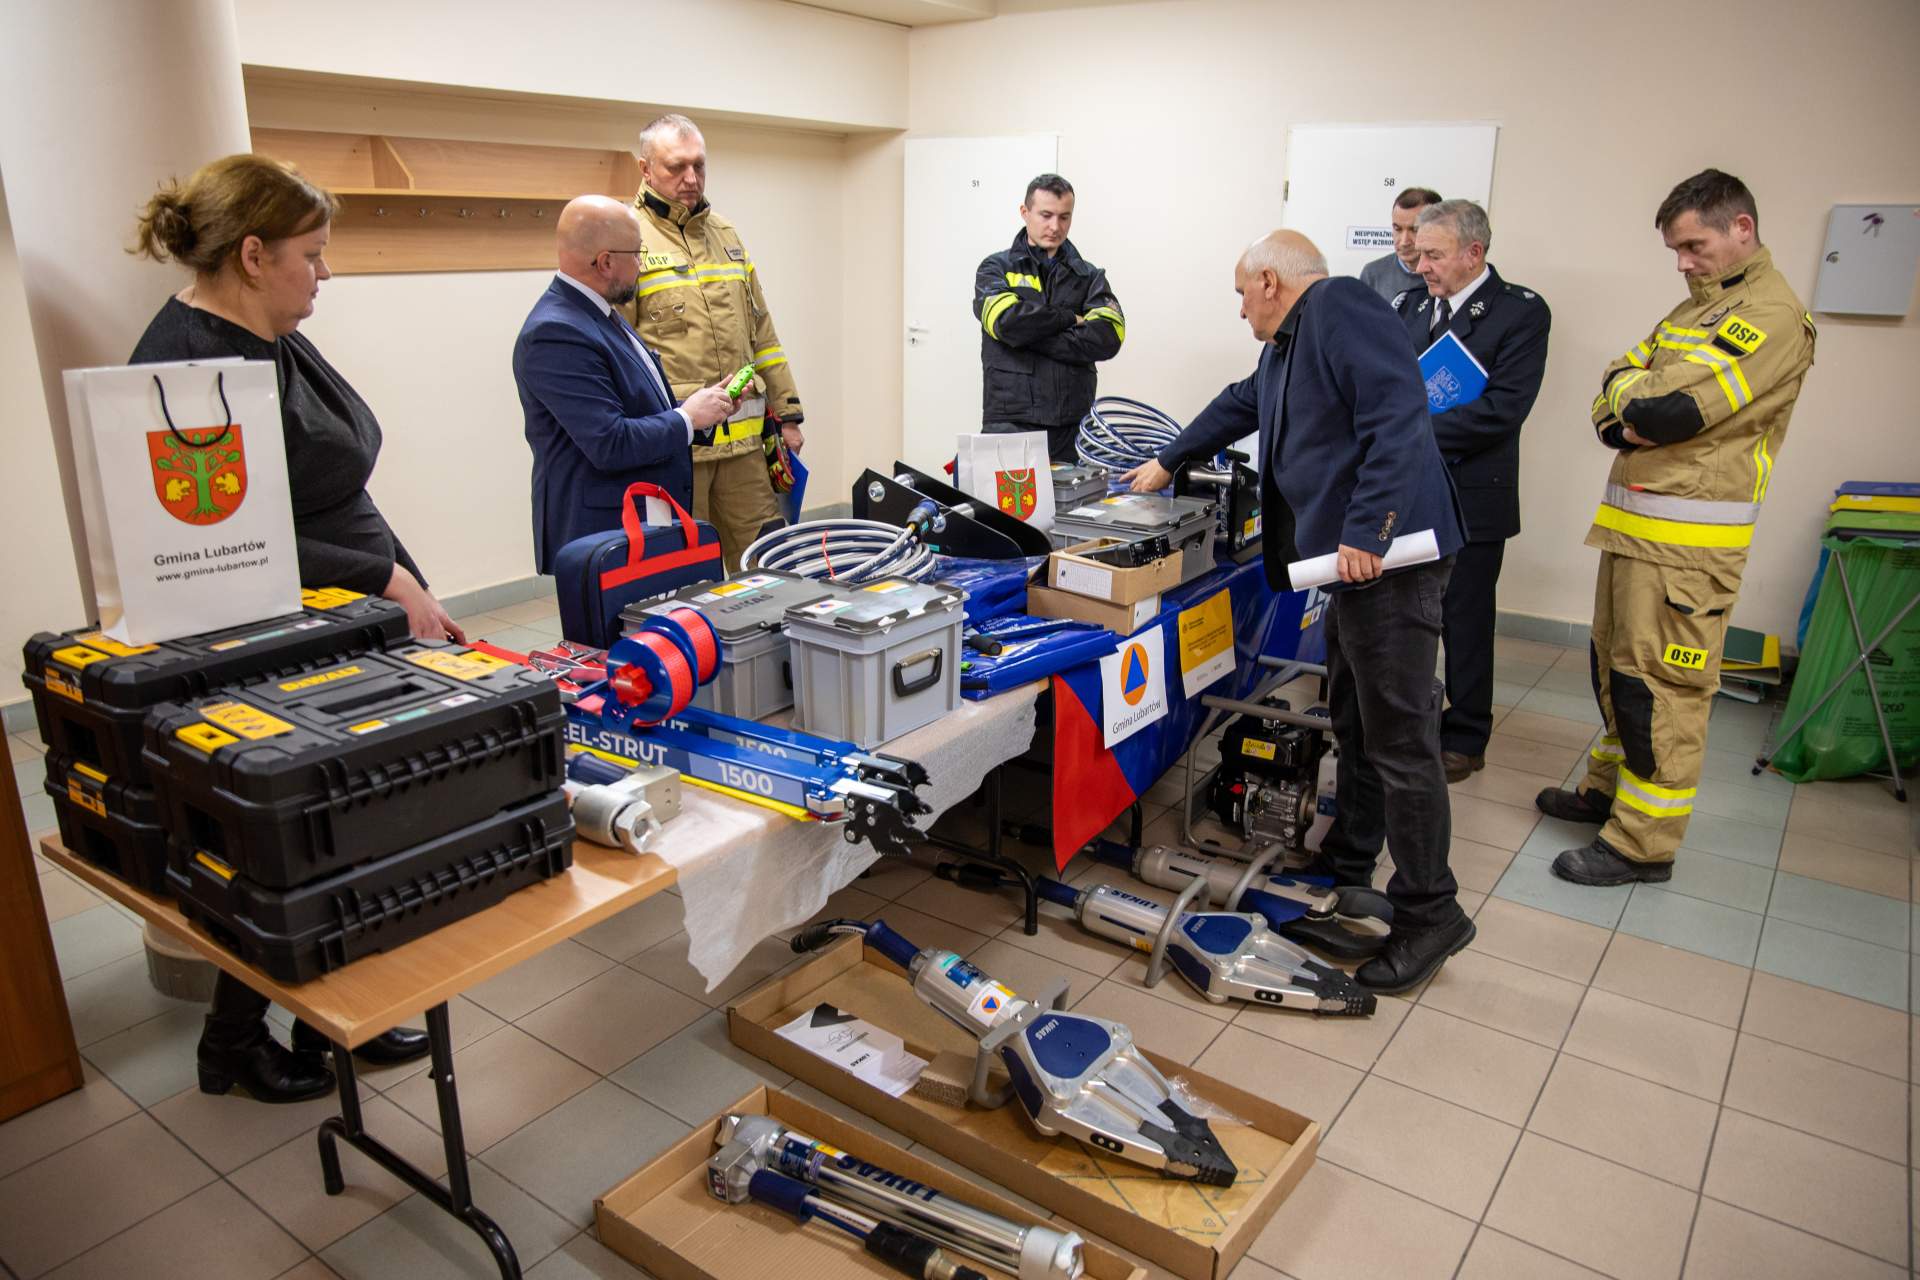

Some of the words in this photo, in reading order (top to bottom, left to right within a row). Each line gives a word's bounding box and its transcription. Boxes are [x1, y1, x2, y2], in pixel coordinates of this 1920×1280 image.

[1384, 177, 1395, 187] 58
[648, 255, 668, 266] OSP
[1727, 322, 1759, 344] OSP
[153, 551, 200, 567] Gmina
[204, 540, 266, 559] Lubartów
[156, 556, 269, 582] www.gmina-lubartow.pl
[1670, 648, 1702, 665] OSP
[1112, 716, 1132, 735] Gmina
[563, 723, 668, 766] EL-STRUT
[718, 761, 774, 795] 1500
[1034, 1018, 1060, 1041] LUKAS
